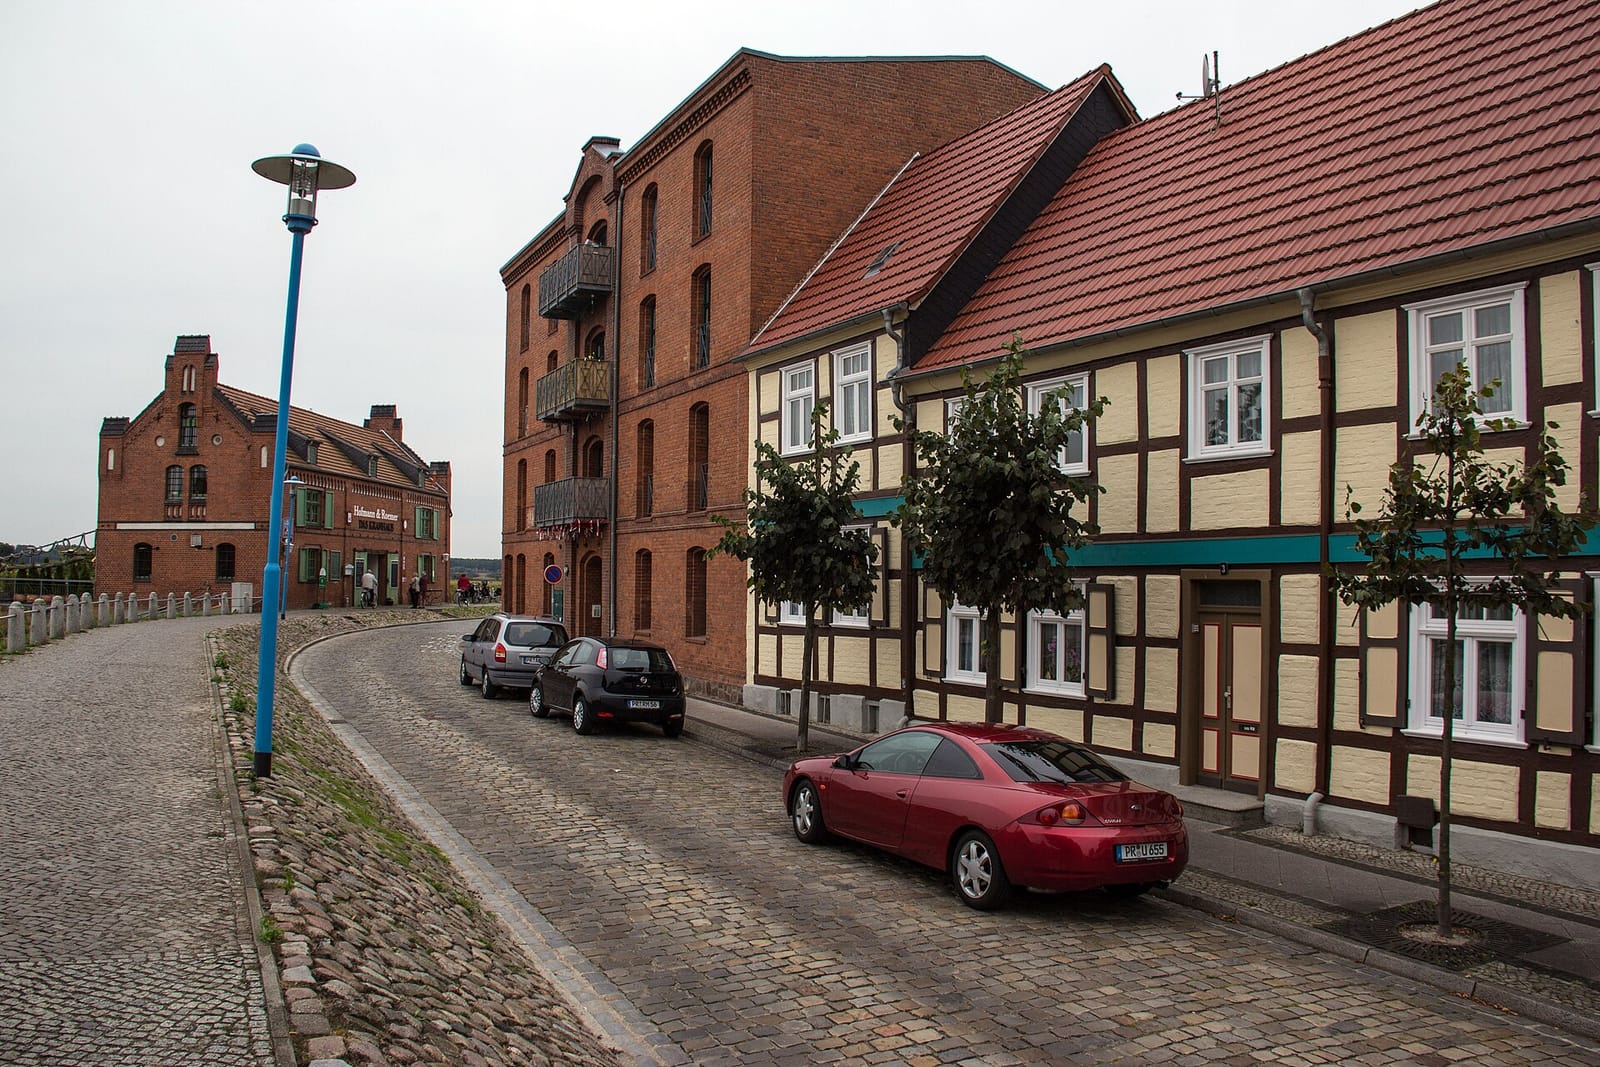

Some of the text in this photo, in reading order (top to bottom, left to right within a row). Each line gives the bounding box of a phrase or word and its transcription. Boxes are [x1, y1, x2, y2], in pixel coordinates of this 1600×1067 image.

[376, 508, 381, 519] &
[1125, 844, 1165, 857] PR U 655
